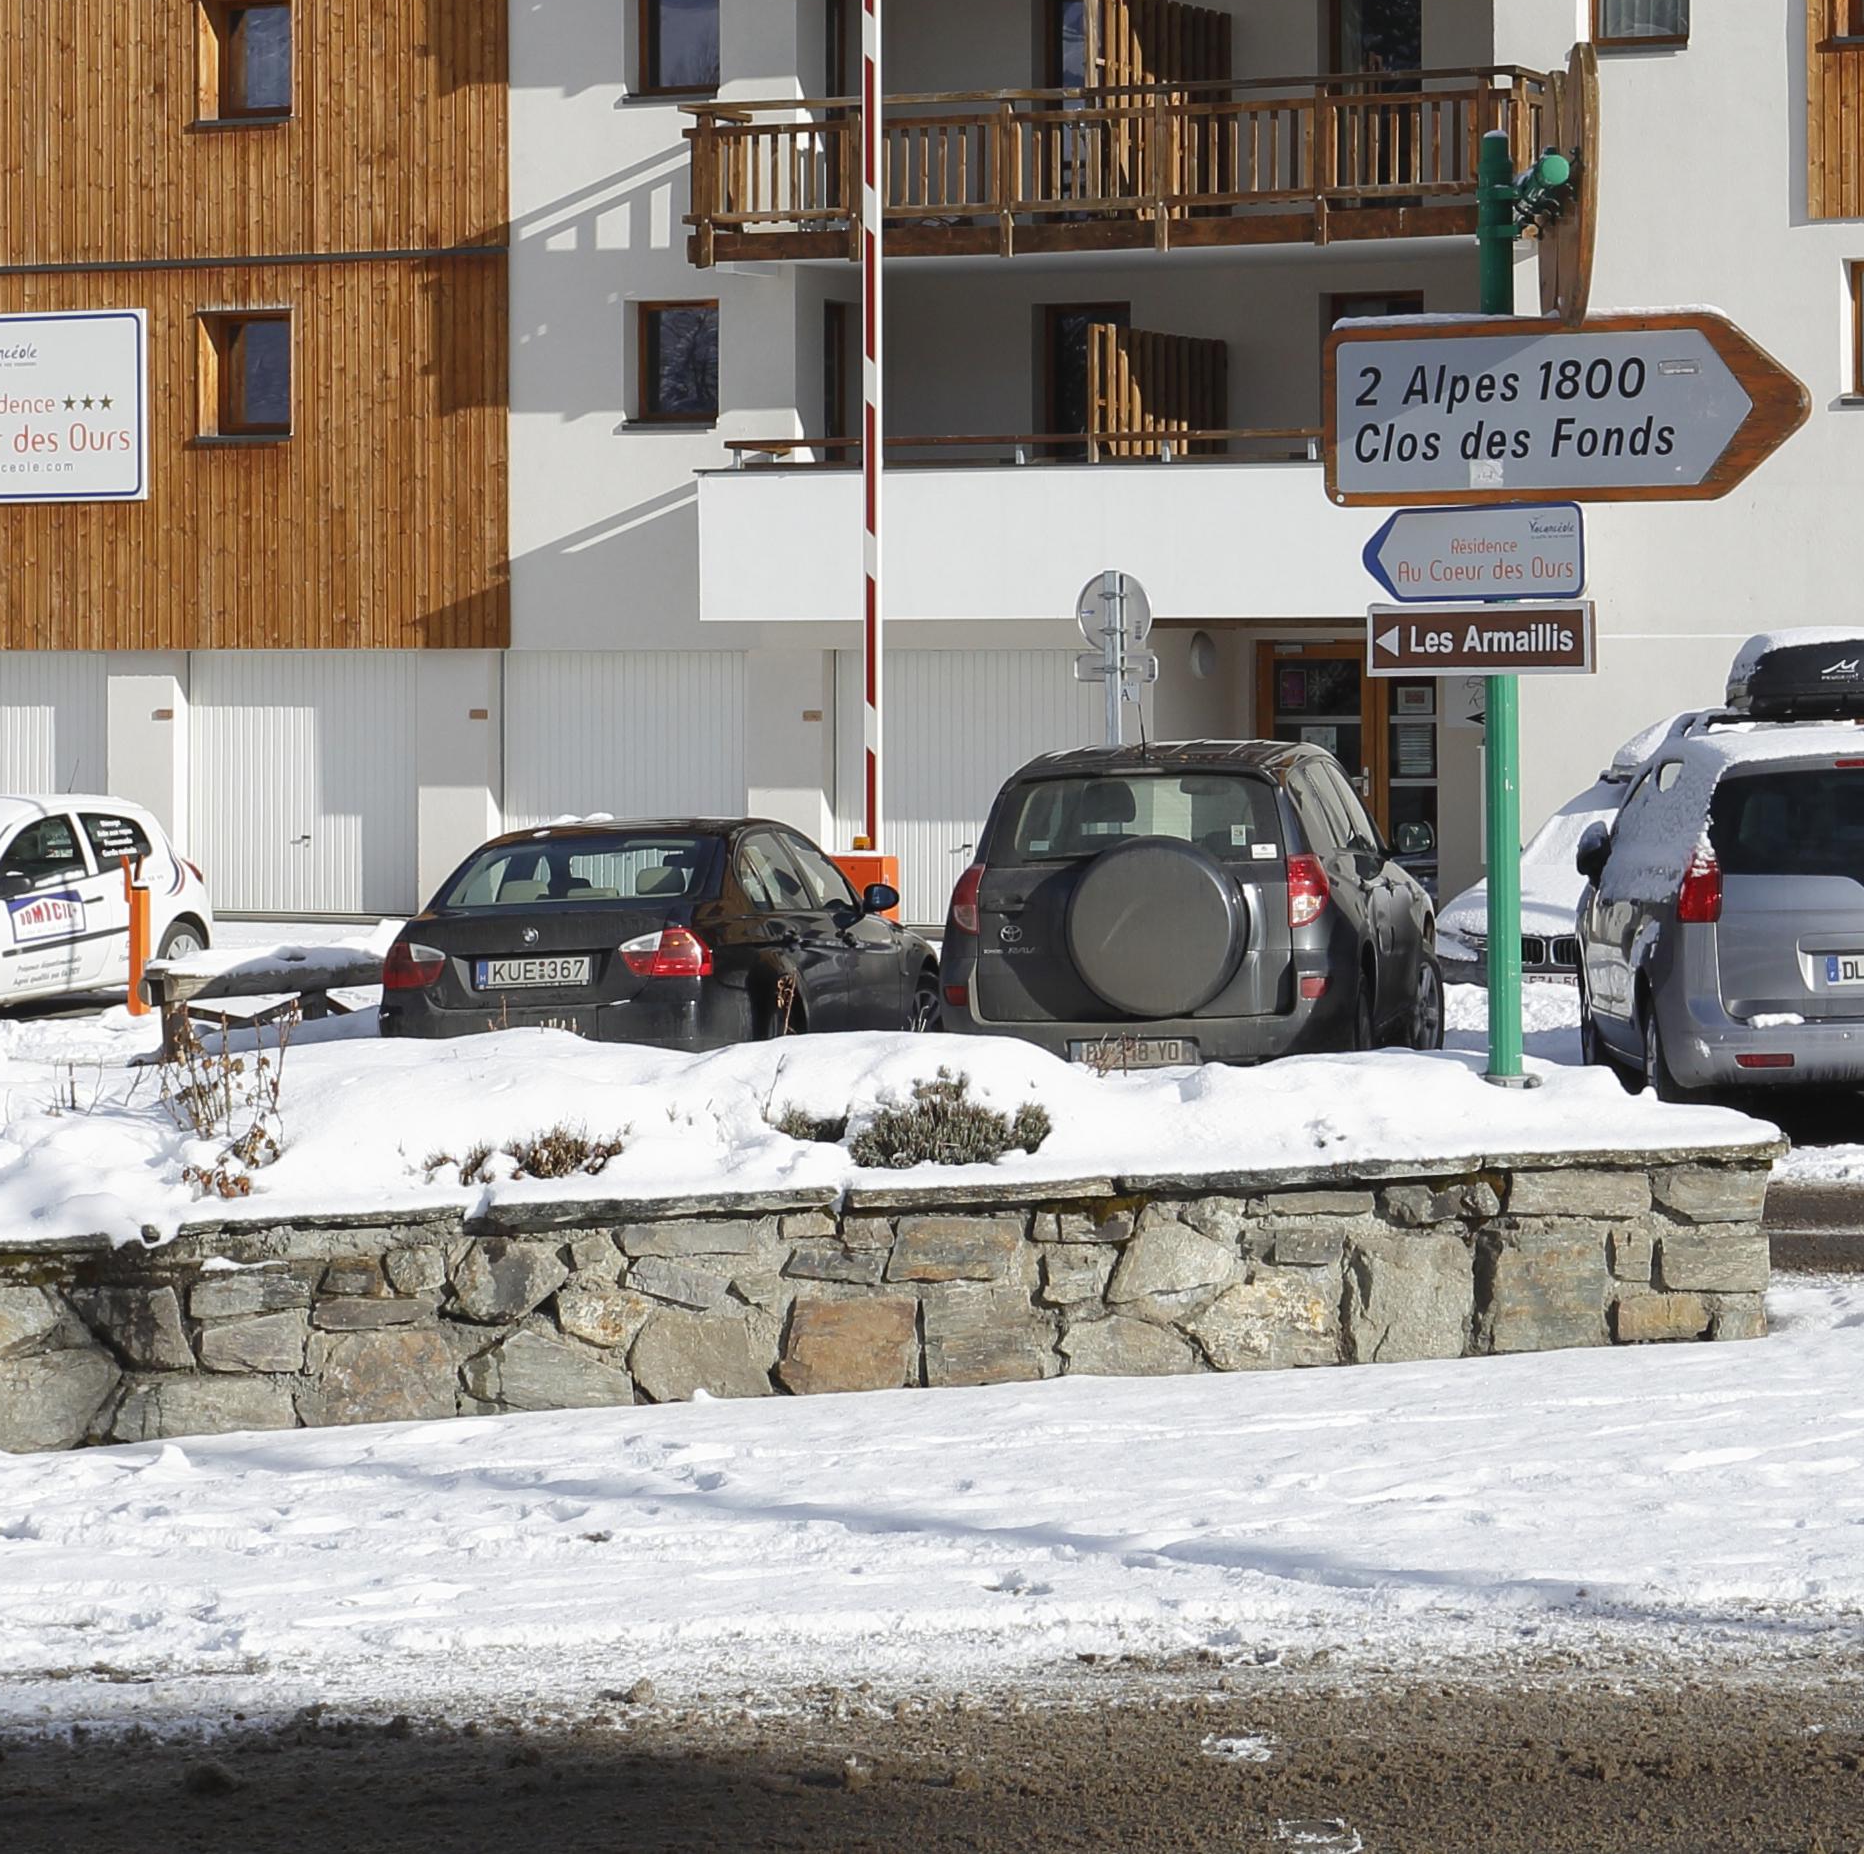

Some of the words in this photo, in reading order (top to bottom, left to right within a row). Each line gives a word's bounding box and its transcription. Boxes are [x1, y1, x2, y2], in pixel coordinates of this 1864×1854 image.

[1355, 366, 1382, 407] 2
[1401, 364, 1520, 415] Alpes
[1539, 357, 1646, 400] 1800
[13, 424, 59, 453] des
[69, 422, 131, 452] Ours
[1354, 422, 1441, 463] Clos
[1460, 420, 1531, 460] des
[1550, 415, 1676, 458] Fonds
[1450, 538, 1518, 555] Résidence
[1397, 561, 1422, 583] Au
[1429, 559, 1484, 582] Coeur
[1492, 557, 1524, 580] des
[1531, 555, 1574, 579] Ours
[1409, 625, 1454, 654] Les
[1461, 623, 1575, 653] Armaillis
